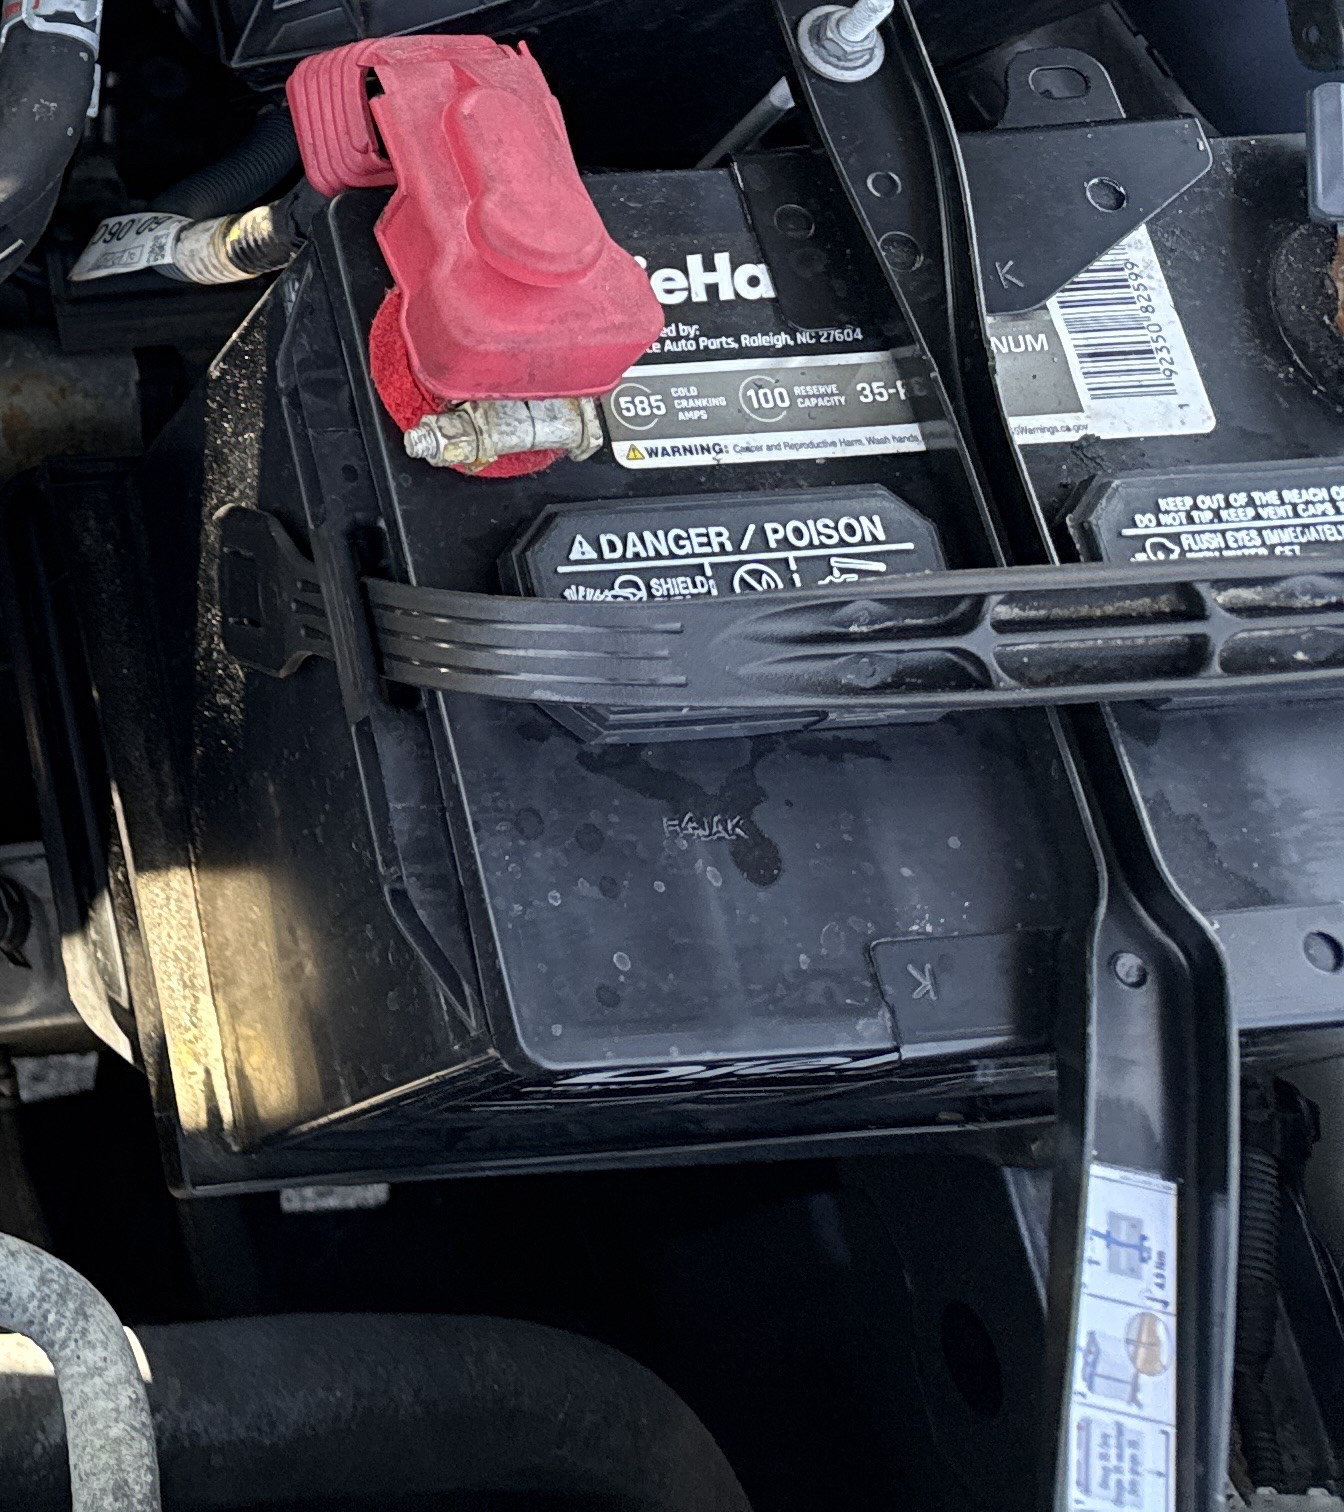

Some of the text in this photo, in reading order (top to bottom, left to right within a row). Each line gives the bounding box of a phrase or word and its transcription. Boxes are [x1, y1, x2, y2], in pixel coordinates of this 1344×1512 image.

[1123, 261, 1179, 378] 92350 82599
[664, 338, 697, 353] Auto
[699, 336, 739, 350] Parts,
[741, 331, 795, 348] Raleigh,
[797, 331, 816, 344] NC
[819, 327, 863, 343] 27604
[678, 324, 700, 339] by:
[989, 333, 1049, 354] NUM
[670, 386, 698, 398] COLD
[746, 387, 791, 410] 100
[793, 383, 840, 396] RESERVE
[619, 393, 667, 418] 585
[674, 396, 727, 409] CRANKING
[796, 395, 846, 408] CAPACITY
[677, 409, 708, 421] AMPS
[645, 442, 730, 461] WARNING:
[733, 443, 764, 454] Cancer
[766, 440, 782, 451] and
[783, 437, 838, 452] Reproductive
[865, 435, 891, 444] Wash
[1158, 496, 1194, 512] KEEP
[1196, 494, 1225, 510] OUT
[1229, 492, 1249, 507] OF
[1251, 490, 1282, 506] THE
[1282, 488, 1330, 504] REACH
[1134, 513, 1157, 528] DO
[1160, 511, 1188, 526] NOT
[1219, 507, 1256, 522] KEEP
[1258, 504, 1295, 520] VENT
[1296, 501, 1336, 517] CAPS
[600, 514, 887, 561] DANGER / POISON
[1180, 532, 1226, 551] FLUSH
[1225, 529, 1262, 548] EYES
[649, 575, 708, 597] SHIELD
